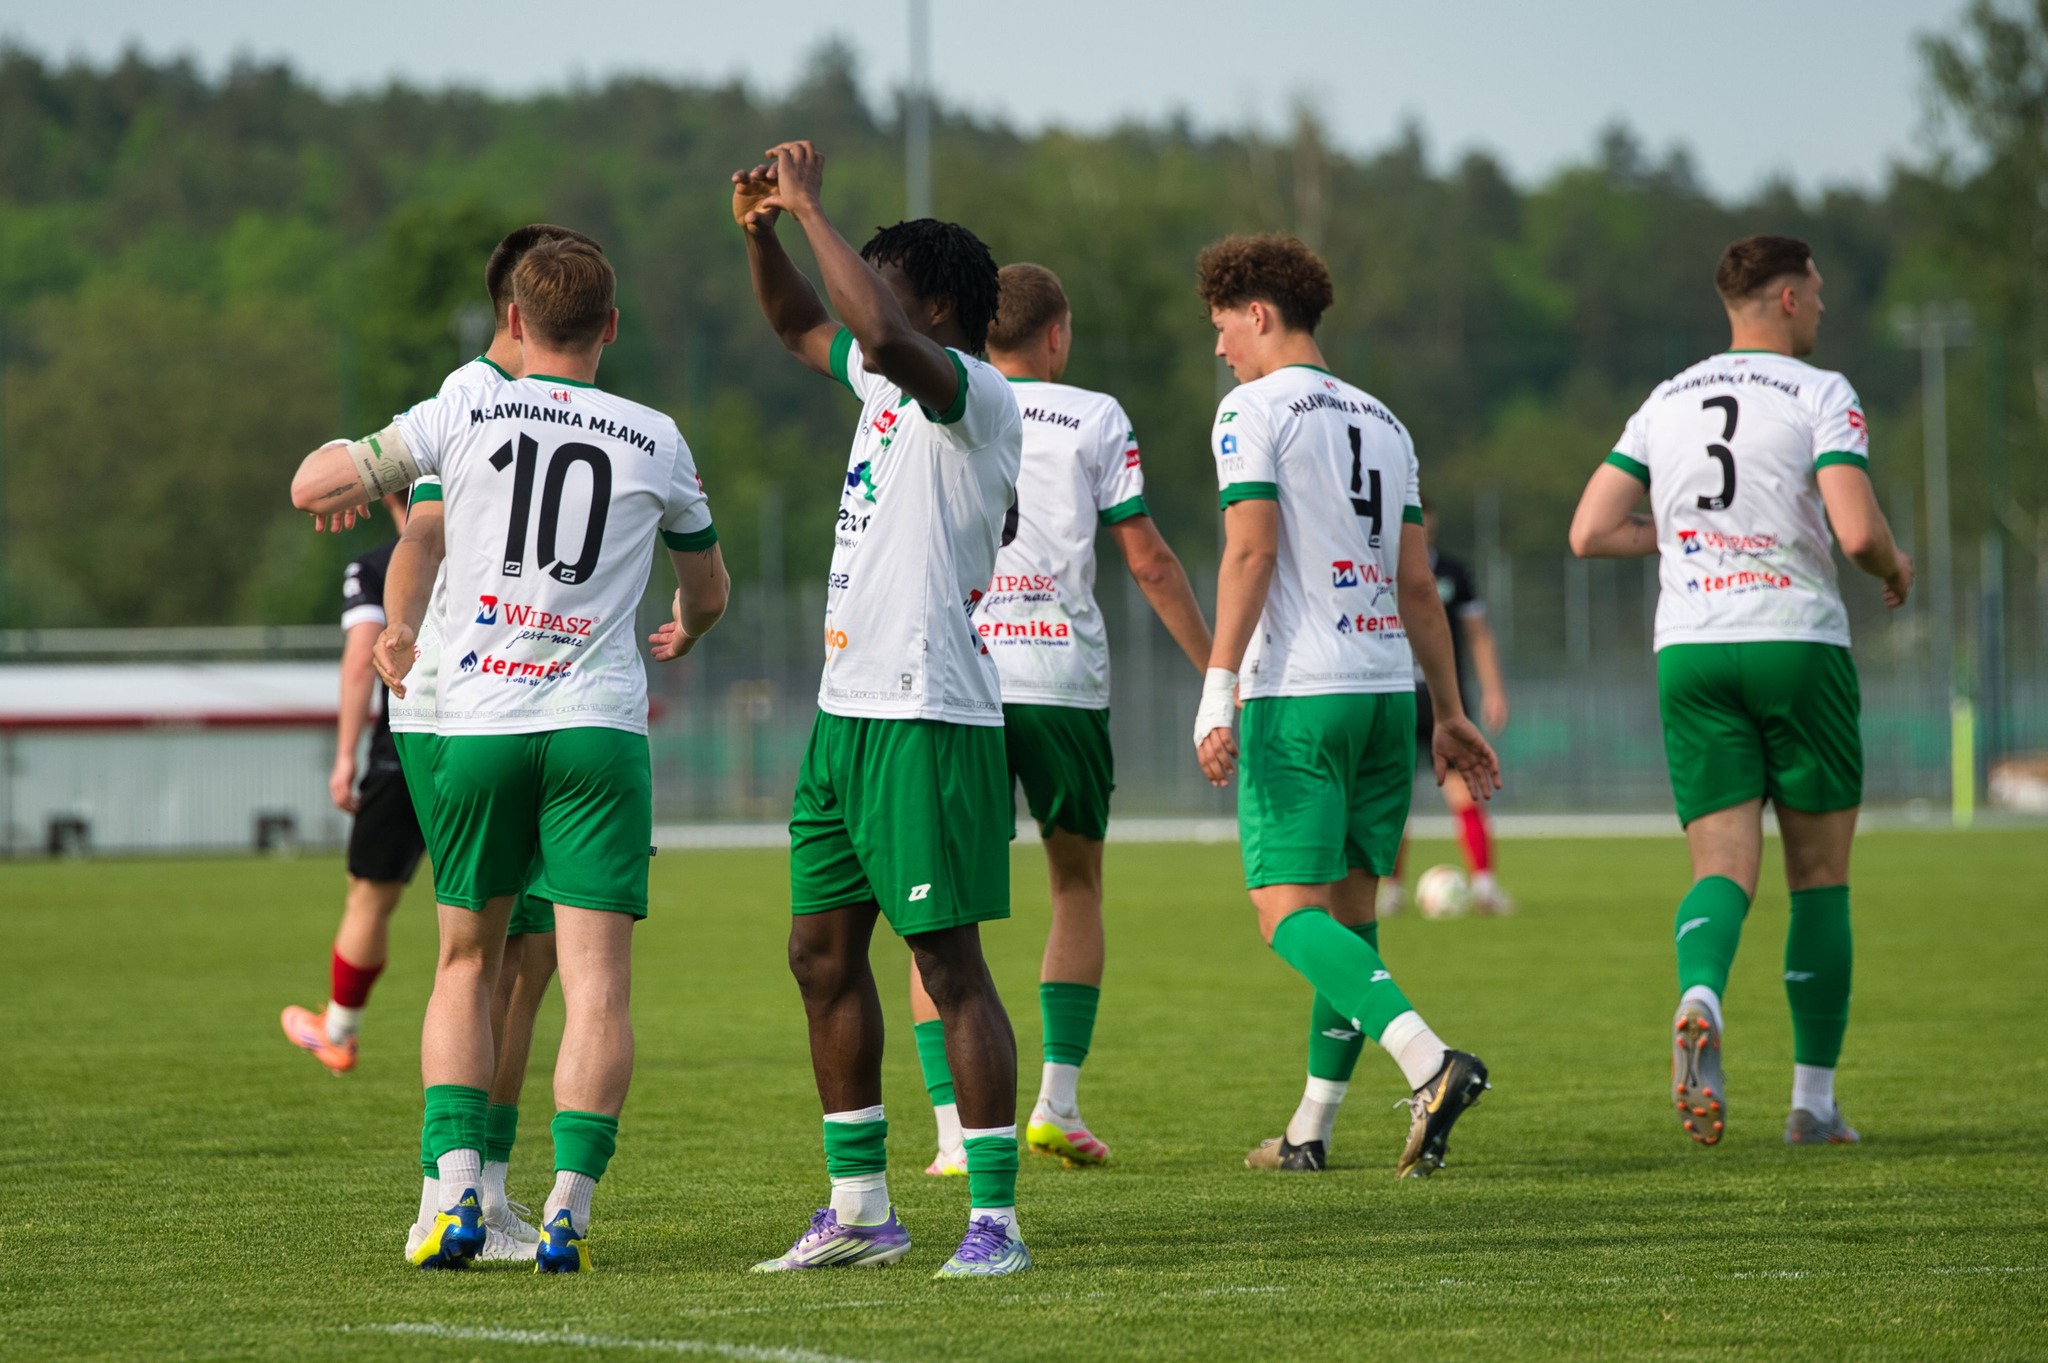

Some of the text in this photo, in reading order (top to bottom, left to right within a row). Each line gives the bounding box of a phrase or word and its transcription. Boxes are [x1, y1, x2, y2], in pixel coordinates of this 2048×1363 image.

[470, 402, 656, 457] MŁAWIANKA MŁAWA
[1022, 407, 1081, 430] MŁAWA
[1696, 395, 1740, 512] 3
[1347, 423, 1383, 549] 4
[488, 431, 613, 586] 10
[503, 603, 593, 637] WIPASZ
[505, 627, 584, 649] jest nasz
[977, 620, 1069, 638] ermika
